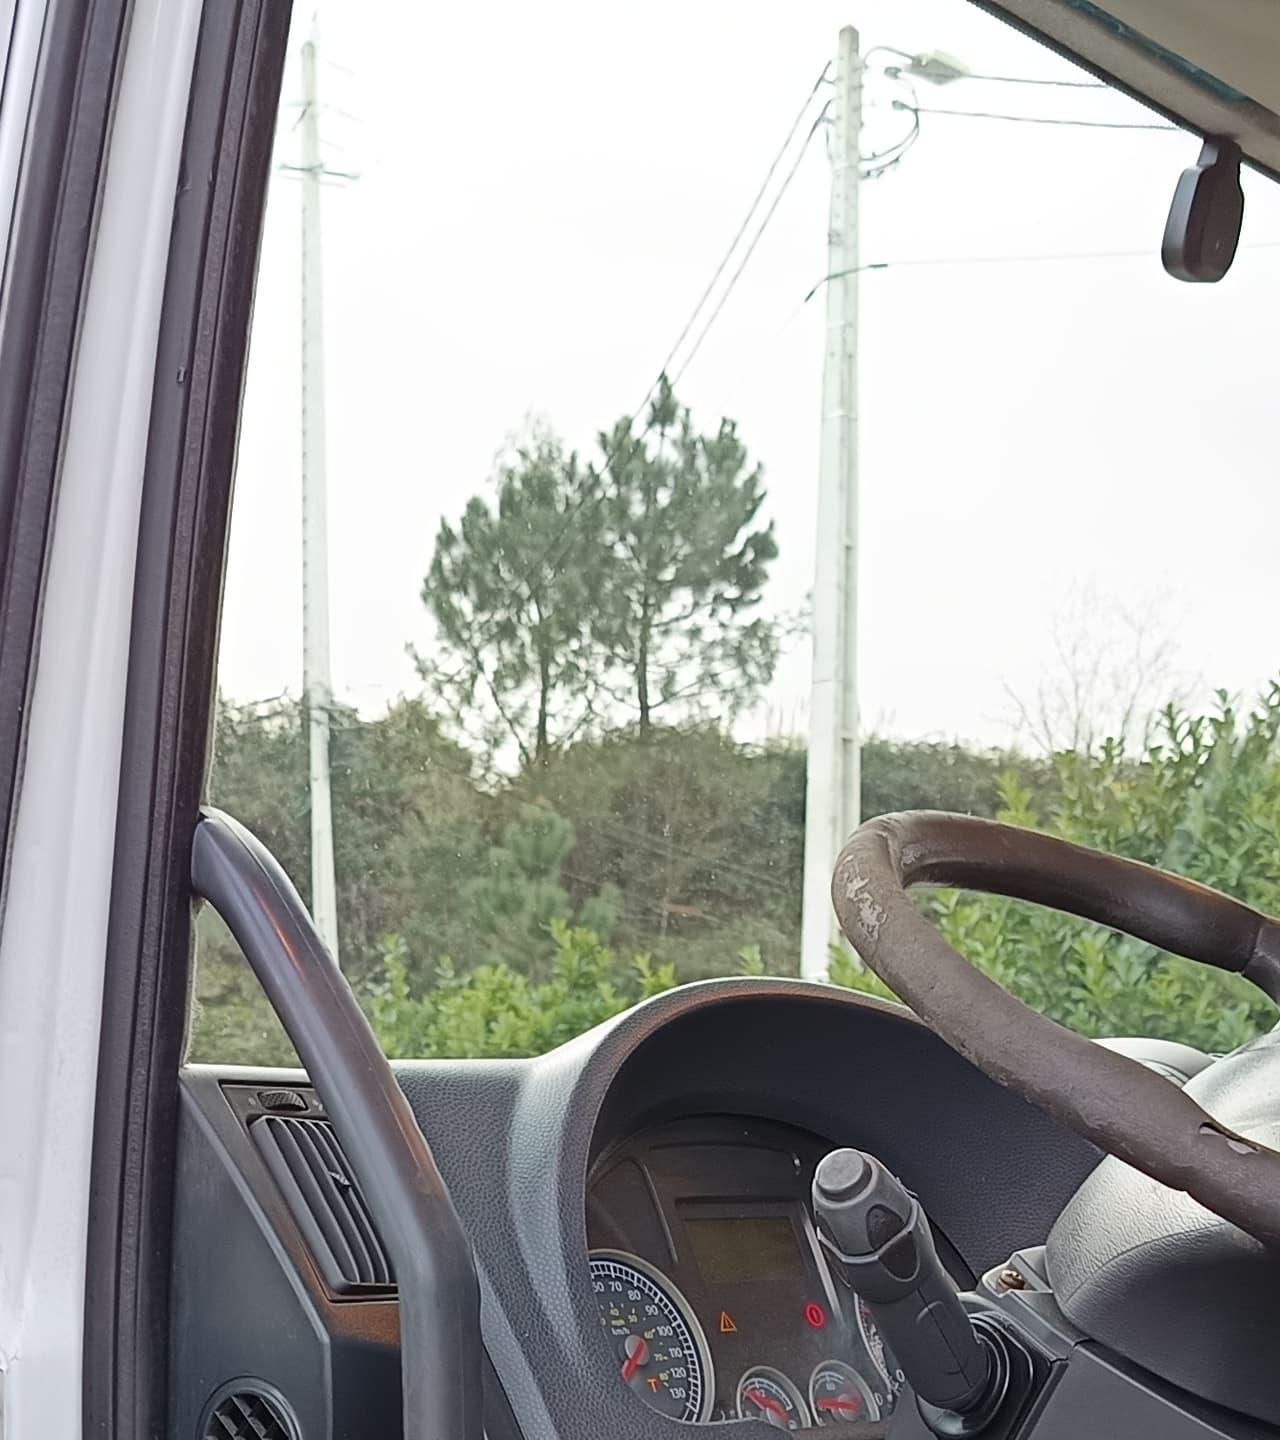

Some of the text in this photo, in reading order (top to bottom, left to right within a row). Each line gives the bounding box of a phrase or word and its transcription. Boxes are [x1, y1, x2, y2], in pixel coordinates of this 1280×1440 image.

[608, 1281, 622, 1292] 70
[627, 1289, 641, 1301] 80
[645, 1304, 659, 1316] 90
[656, 1326, 673, 1336] 100
[668, 1347, 683, 1358] 110
[670, 1367, 687, 1378] 120
[670, 1387, 686, 1399] 130
